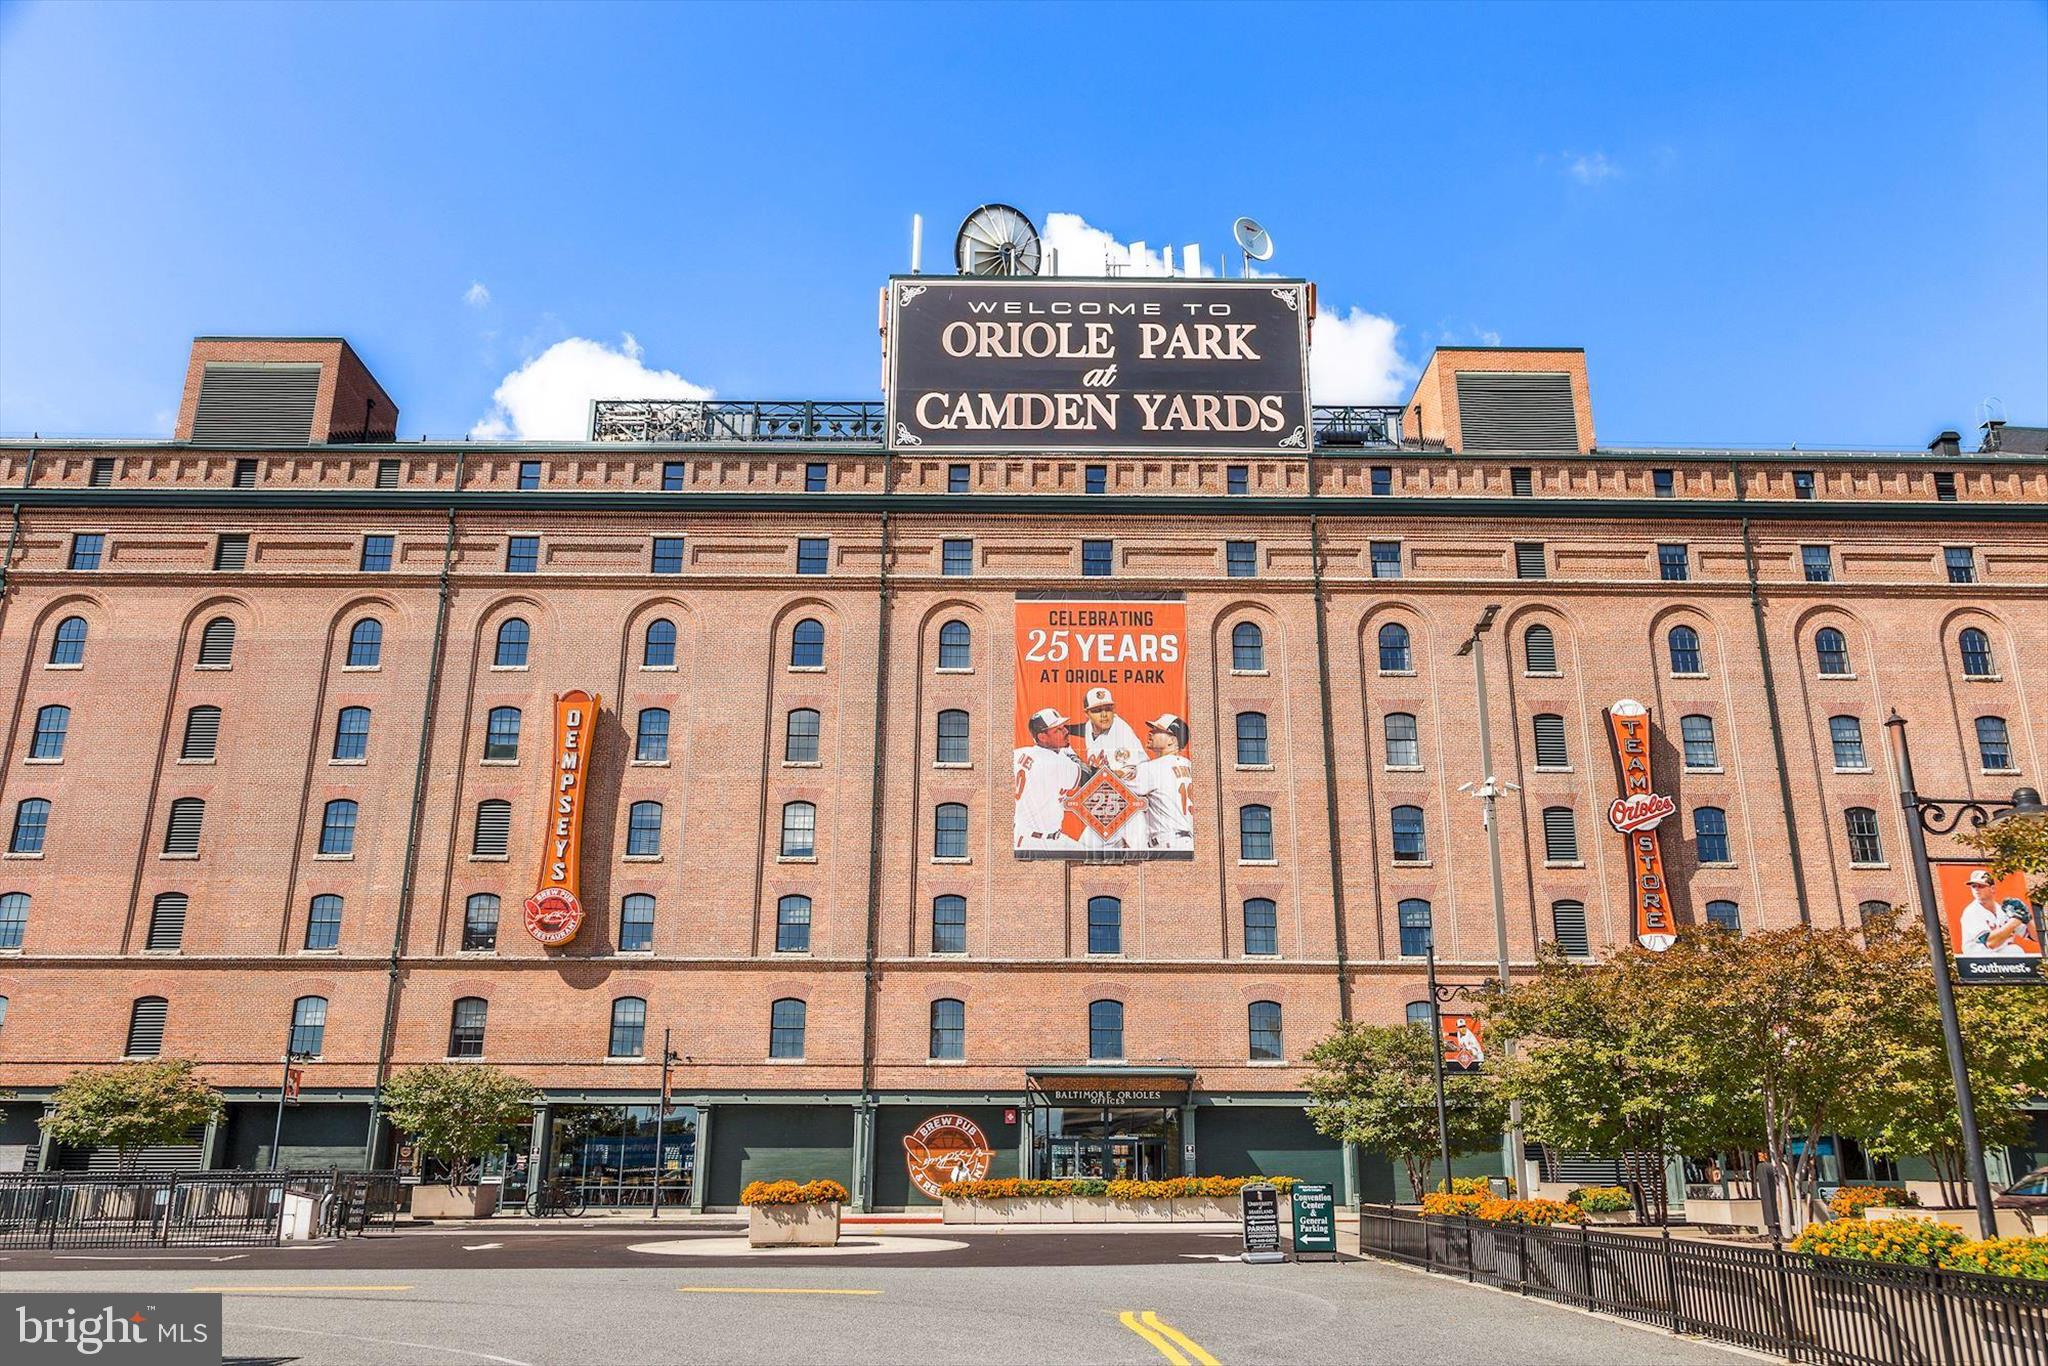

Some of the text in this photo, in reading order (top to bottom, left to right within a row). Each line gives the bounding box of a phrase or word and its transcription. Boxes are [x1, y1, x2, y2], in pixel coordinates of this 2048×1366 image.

[967, 302, 1231, 316] WELCOME TO
[941, 321, 1261, 360] ORIOLE PARK
[1082, 363, 1118, 388] at
[914, 392, 1286, 432] CAMDEN YARDS
[1049, 610, 1153, 626] CELEBRATING
[1025, 629, 1179, 662] 25 YEARS
[1040, 669, 1165, 683] AT ORIOLE PARK
[1622, 720, 1649, 790] TEAM
[552, 710, 581, 881] DEMPSEYS
[1612, 795, 1674, 828] Orioles
[1638, 836, 1666, 930] STORE
[536, 889, 574, 903] BREW PUB
[1969, 962, 2026, 973] Southwest
[1055, 1090, 1161, 1100] BALTIMORE ORIOLES
[920, 1117, 977, 1137] BREW PUB
[1293, 1193, 1332, 1201] Convention
[1301, 1201, 1325, 1209] Center
[1300, 1216, 1328, 1224] General
[1309, 1209, 1317, 1217] &
[1300, 1225, 1329, 1234] Parking
